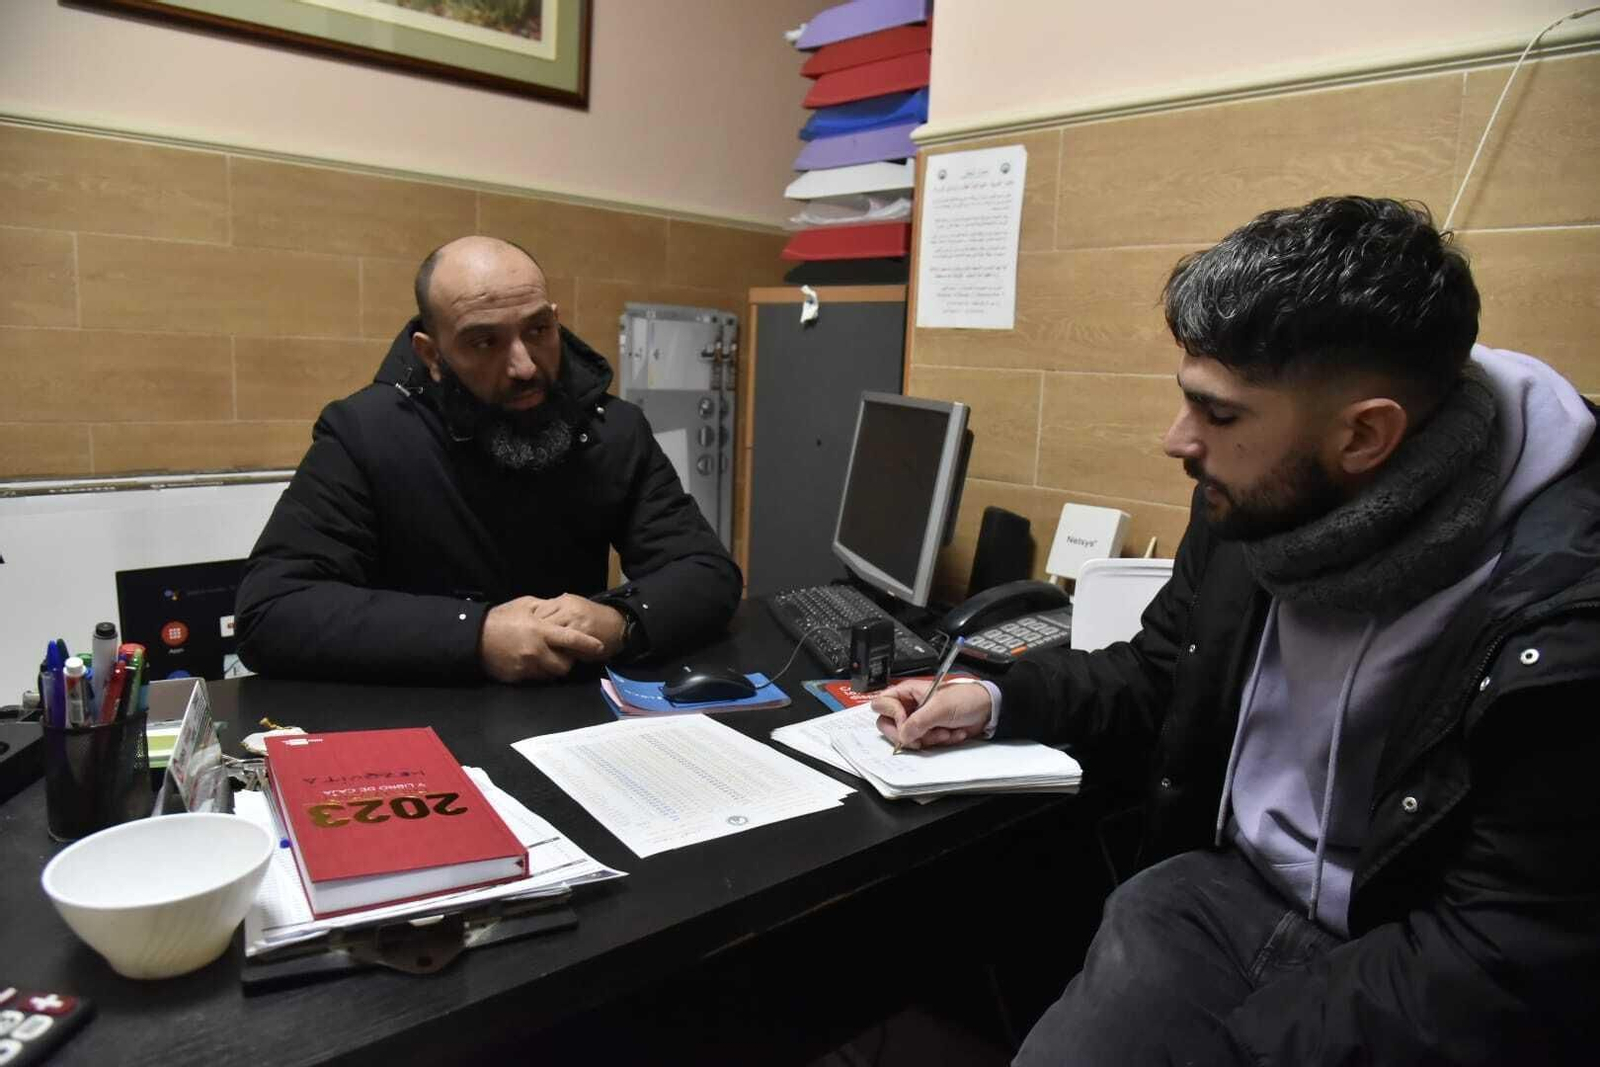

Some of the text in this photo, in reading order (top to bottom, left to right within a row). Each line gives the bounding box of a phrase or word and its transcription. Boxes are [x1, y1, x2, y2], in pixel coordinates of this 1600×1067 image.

[379, 782, 414, 790] LIBRO
[323, 788, 356, 797] CAJA
[308, 792, 468, 828] 2023
